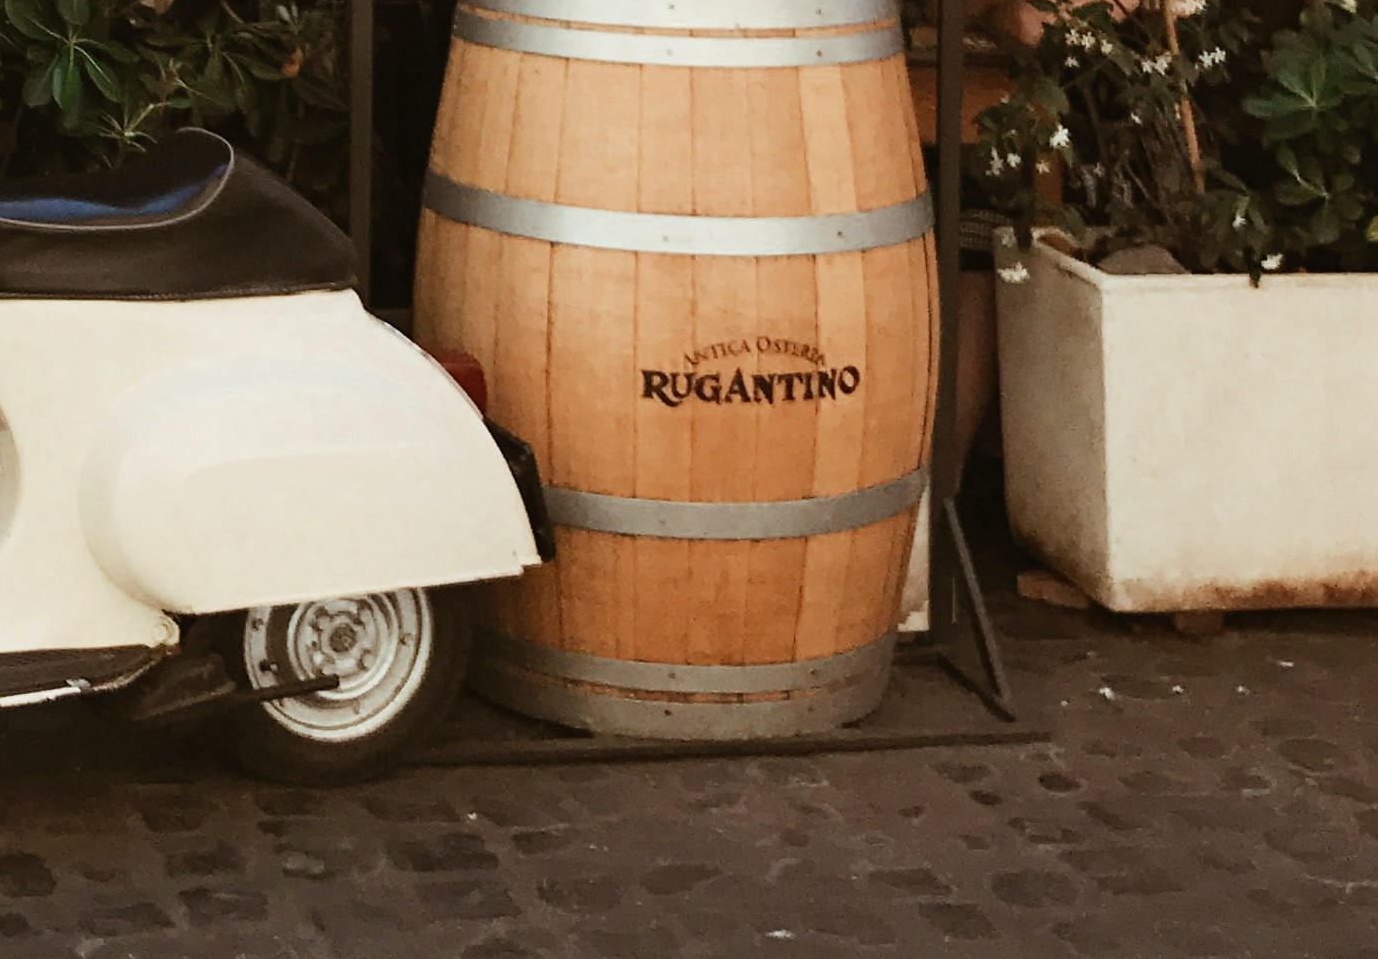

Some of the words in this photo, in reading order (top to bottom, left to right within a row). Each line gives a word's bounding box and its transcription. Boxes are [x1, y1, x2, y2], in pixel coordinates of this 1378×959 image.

[682, 339, 751, 368] ANTICA
[756, 336, 827, 367] OSTERIA
[640, 365, 861, 408] RUGANTINO
